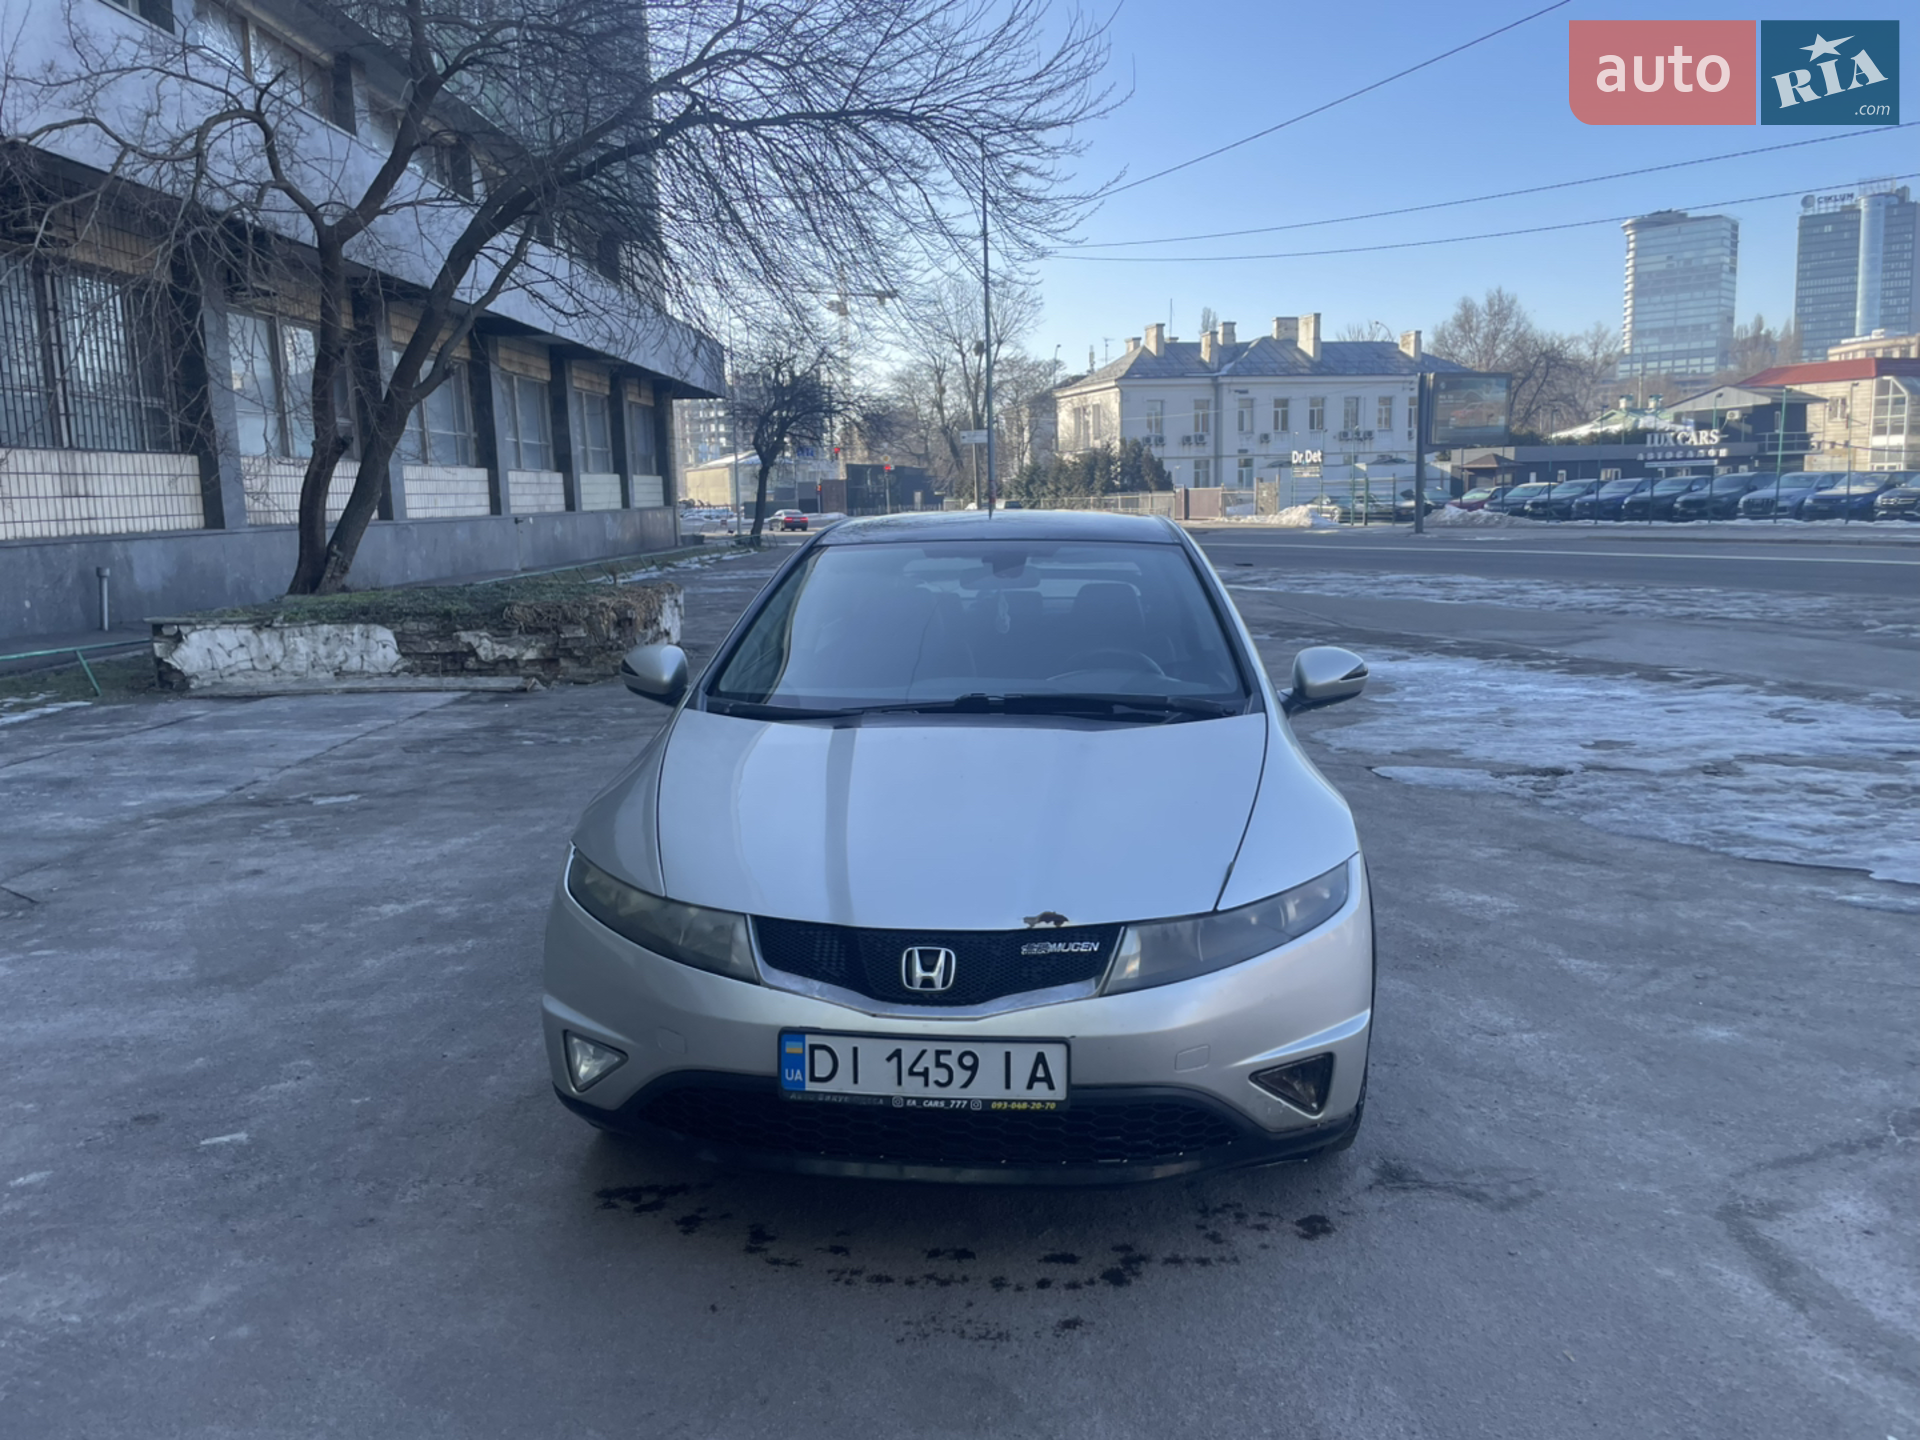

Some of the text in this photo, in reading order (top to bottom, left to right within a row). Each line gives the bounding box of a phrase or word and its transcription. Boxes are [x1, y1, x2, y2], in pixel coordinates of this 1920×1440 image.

[785, 1069, 803, 1082] UA
[809, 1044, 1056, 1091] DI 1459 IA
